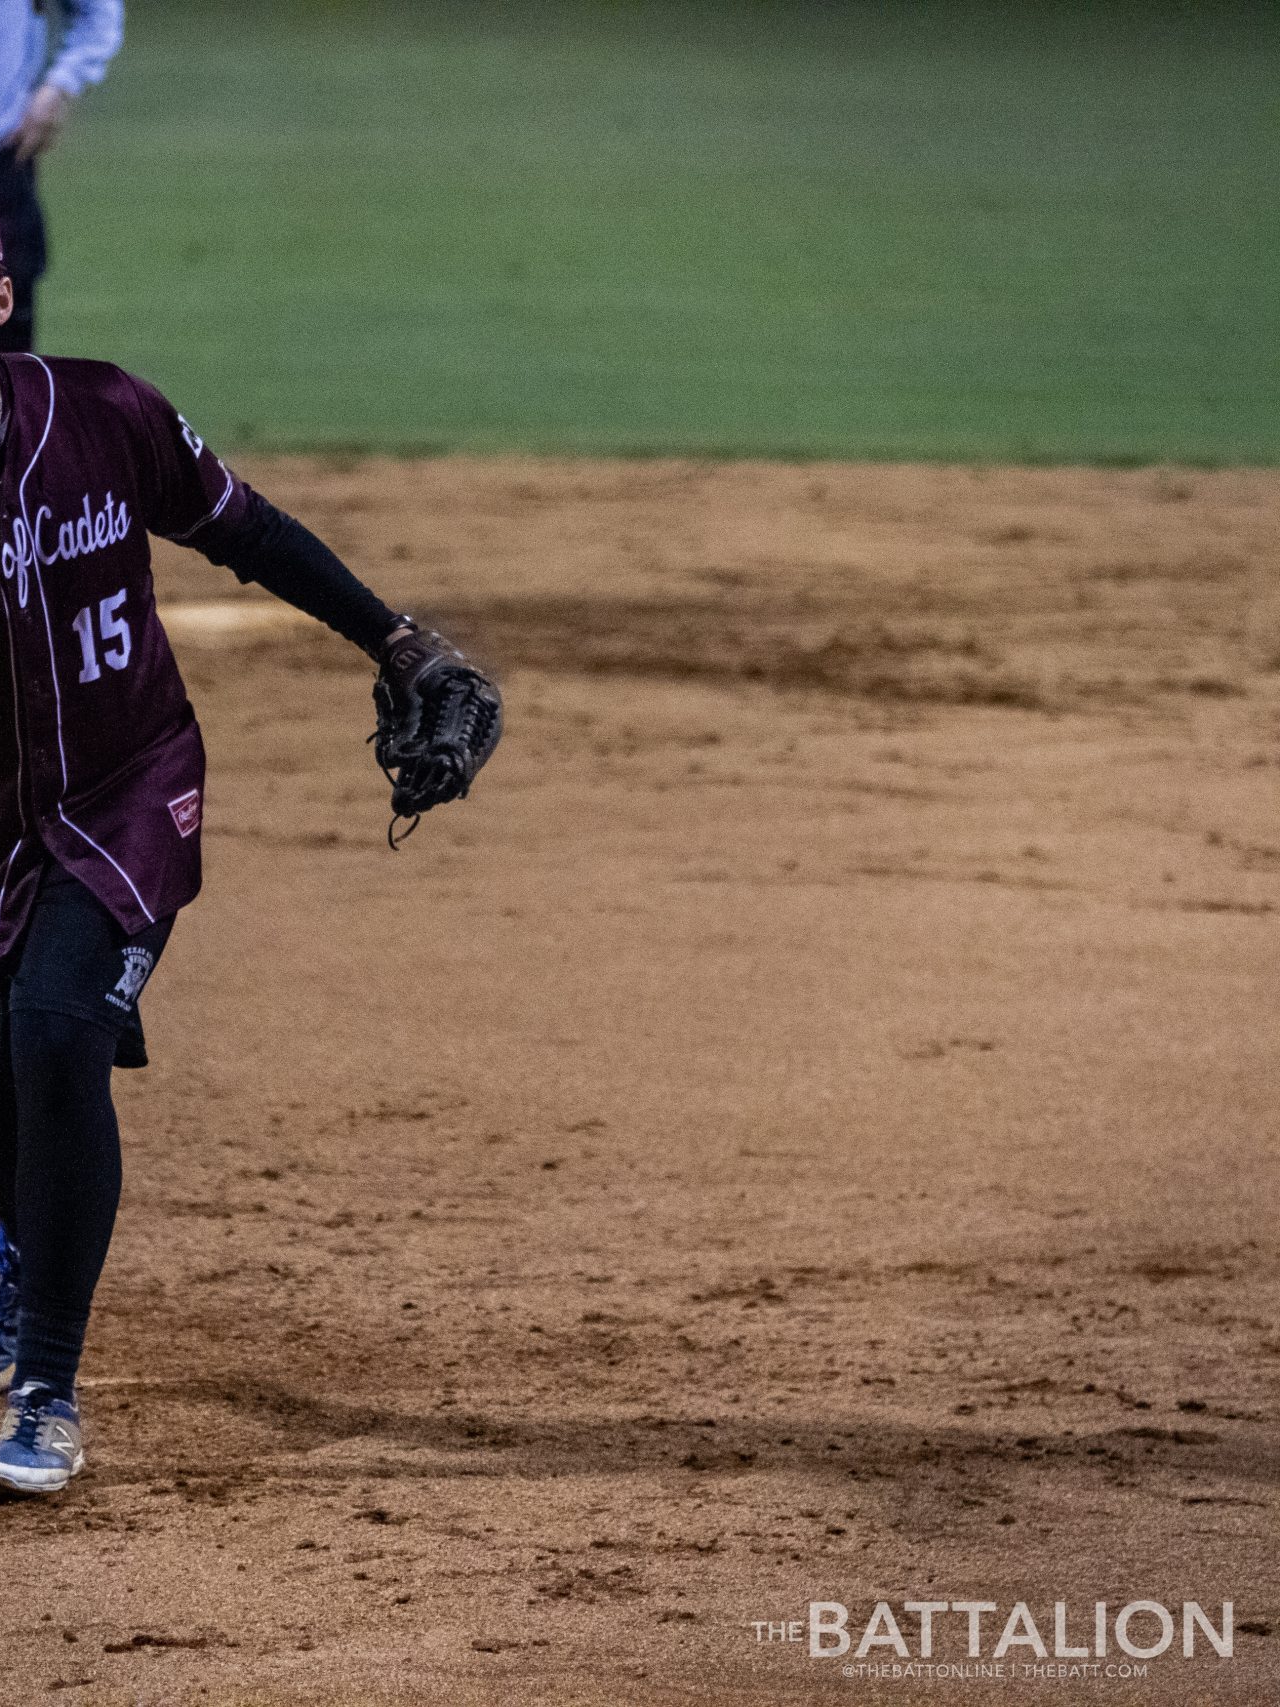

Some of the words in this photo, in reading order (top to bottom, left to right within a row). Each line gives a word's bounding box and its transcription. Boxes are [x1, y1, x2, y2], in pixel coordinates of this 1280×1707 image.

[1, 516, 36, 609] of
[35, 490, 132, 567] Cadets
[71, 588, 133, 684] 15
